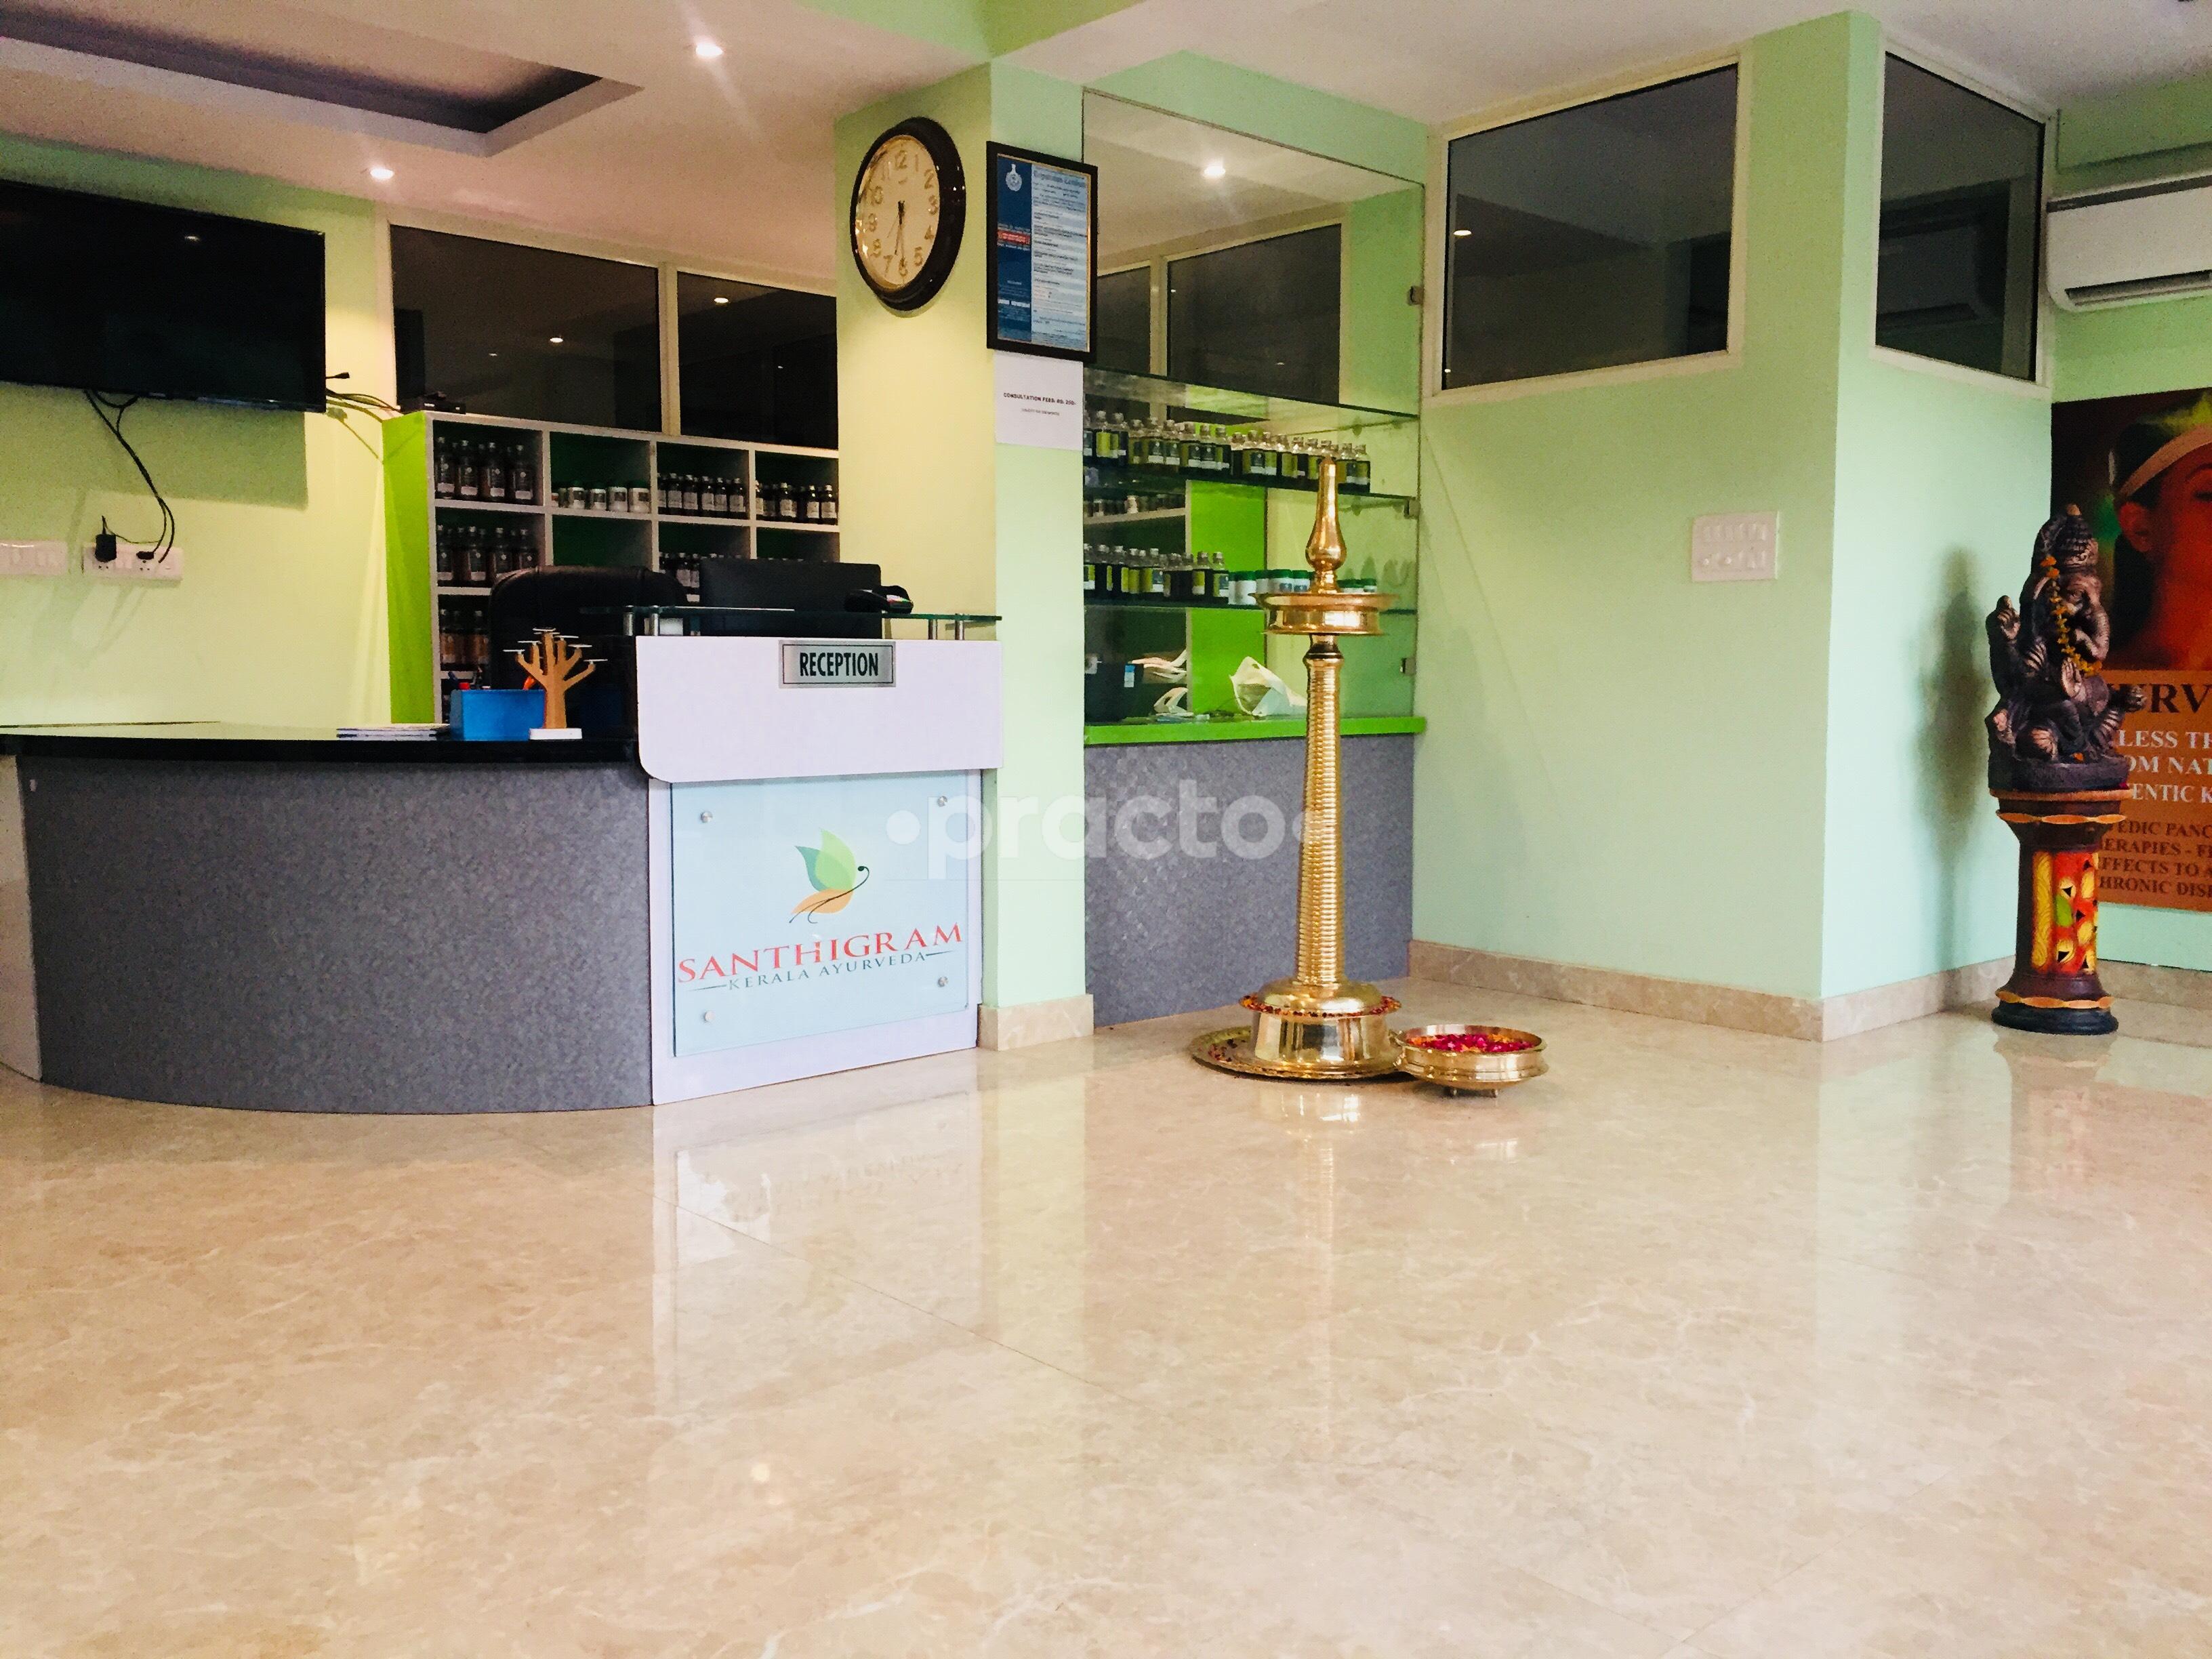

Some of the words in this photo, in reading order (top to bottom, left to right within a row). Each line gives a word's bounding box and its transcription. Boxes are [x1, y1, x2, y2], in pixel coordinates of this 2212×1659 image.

[895, 149, 908, 170] 12
[924, 169, 935, 189] 2
[928, 194, 939, 216] 3
[867, 213, 878, 232] 9
[924, 225, 935, 241] 4
[883, 255, 893, 274] 7
[898, 256, 909, 276] 6
[914, 246, 924, 267] 5
[1003, 392, 1042, 401] CONSULTATION
[800, 652, 879, 676] RECEPTION
[2116, 729, 2179, 748] LESS
[2124, 756, 2159, 773] OM
[2127, 783, 2194, 802] ENTIC
[2111, 820, 2161, 836] EDIC
[2103, 838, 2182, 856] ERAPIES
[2099, 856, 2169, 874] FFECTS
[2174, 862, 2200, 877] TO
[2100, 876, 2171, 894] HRONIC
[678, 922, 963, 983] SANTHIGRAM
[729, 969, 810, 991] KERALA
[819, 951, 926, 977] AYURVEDA
